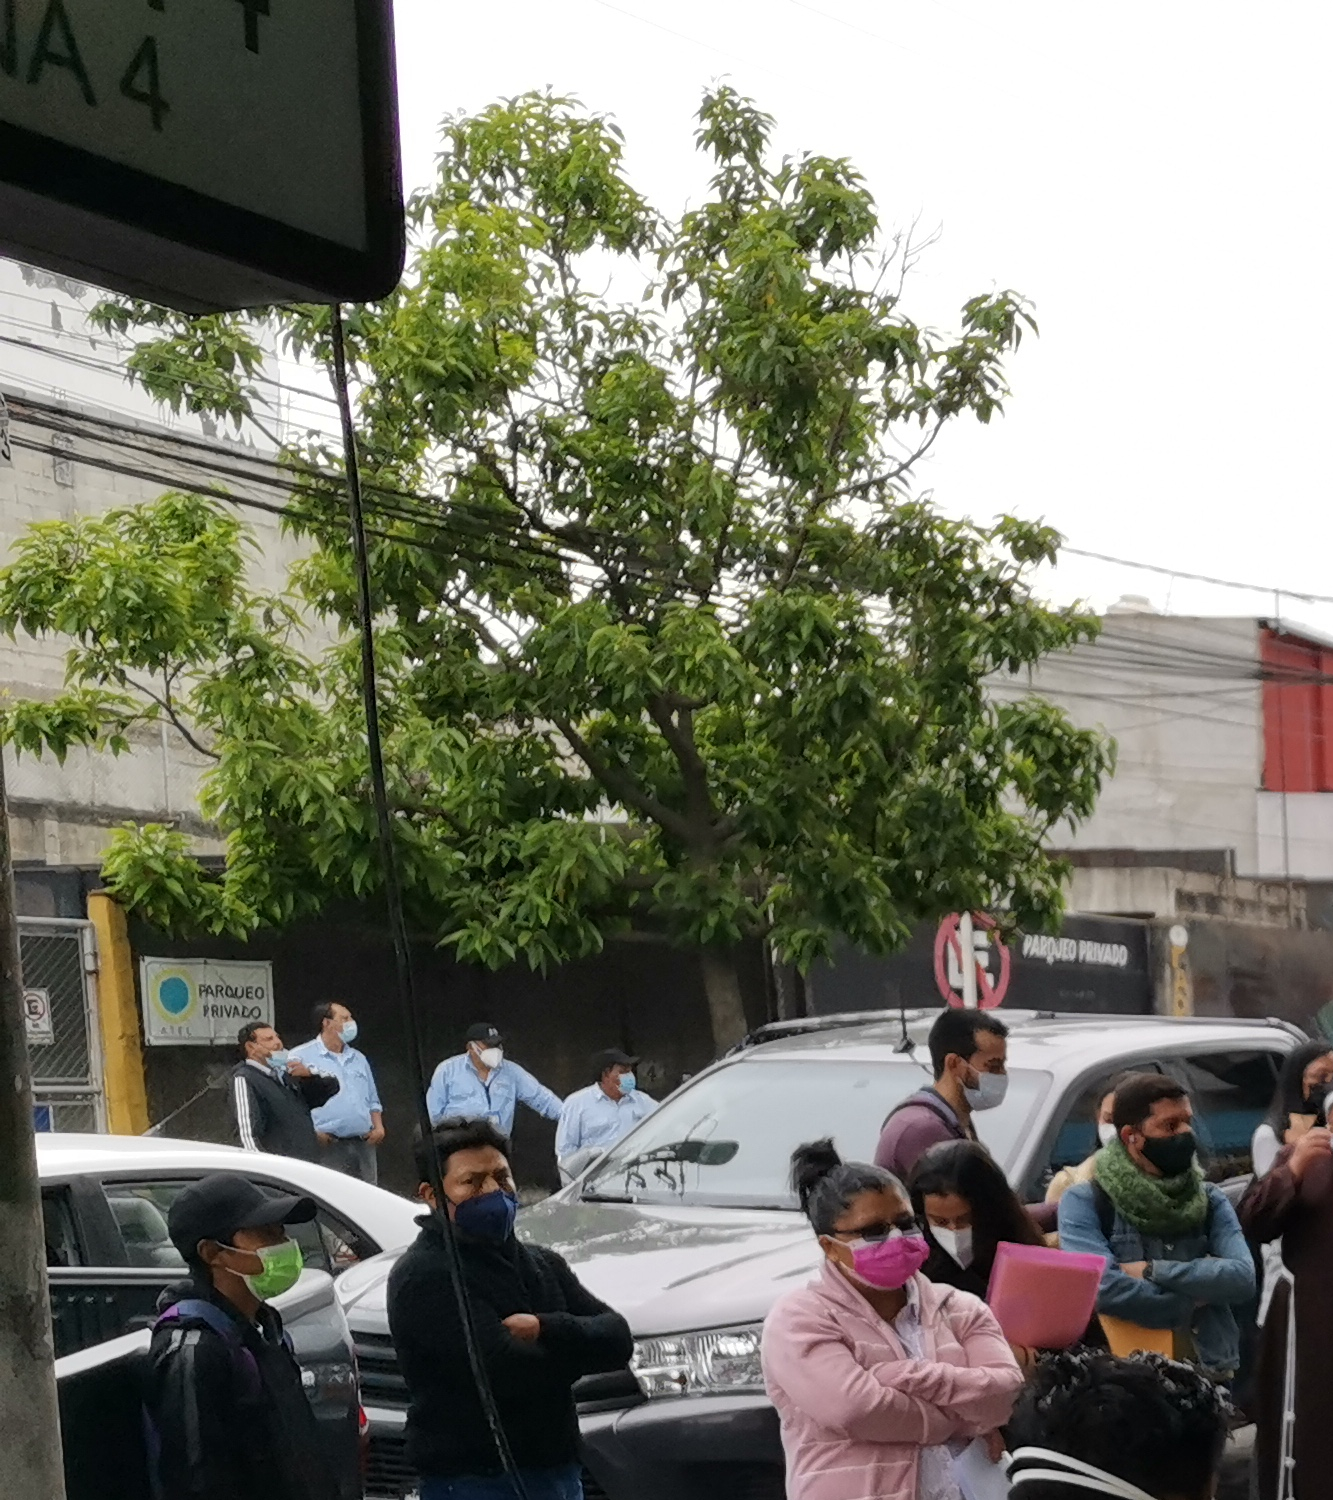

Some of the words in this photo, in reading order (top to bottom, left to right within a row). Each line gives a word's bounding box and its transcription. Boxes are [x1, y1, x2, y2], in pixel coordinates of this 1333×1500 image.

[119, 35, 170, 132] 4
[1022, 934, 1077, 965] PARQUEO
[1078, 940, 1129, 968] PRIVADO
[198, 984, 265, 1000] PARQUEO
[203, 1003, 262, 1020] PRIVADO
